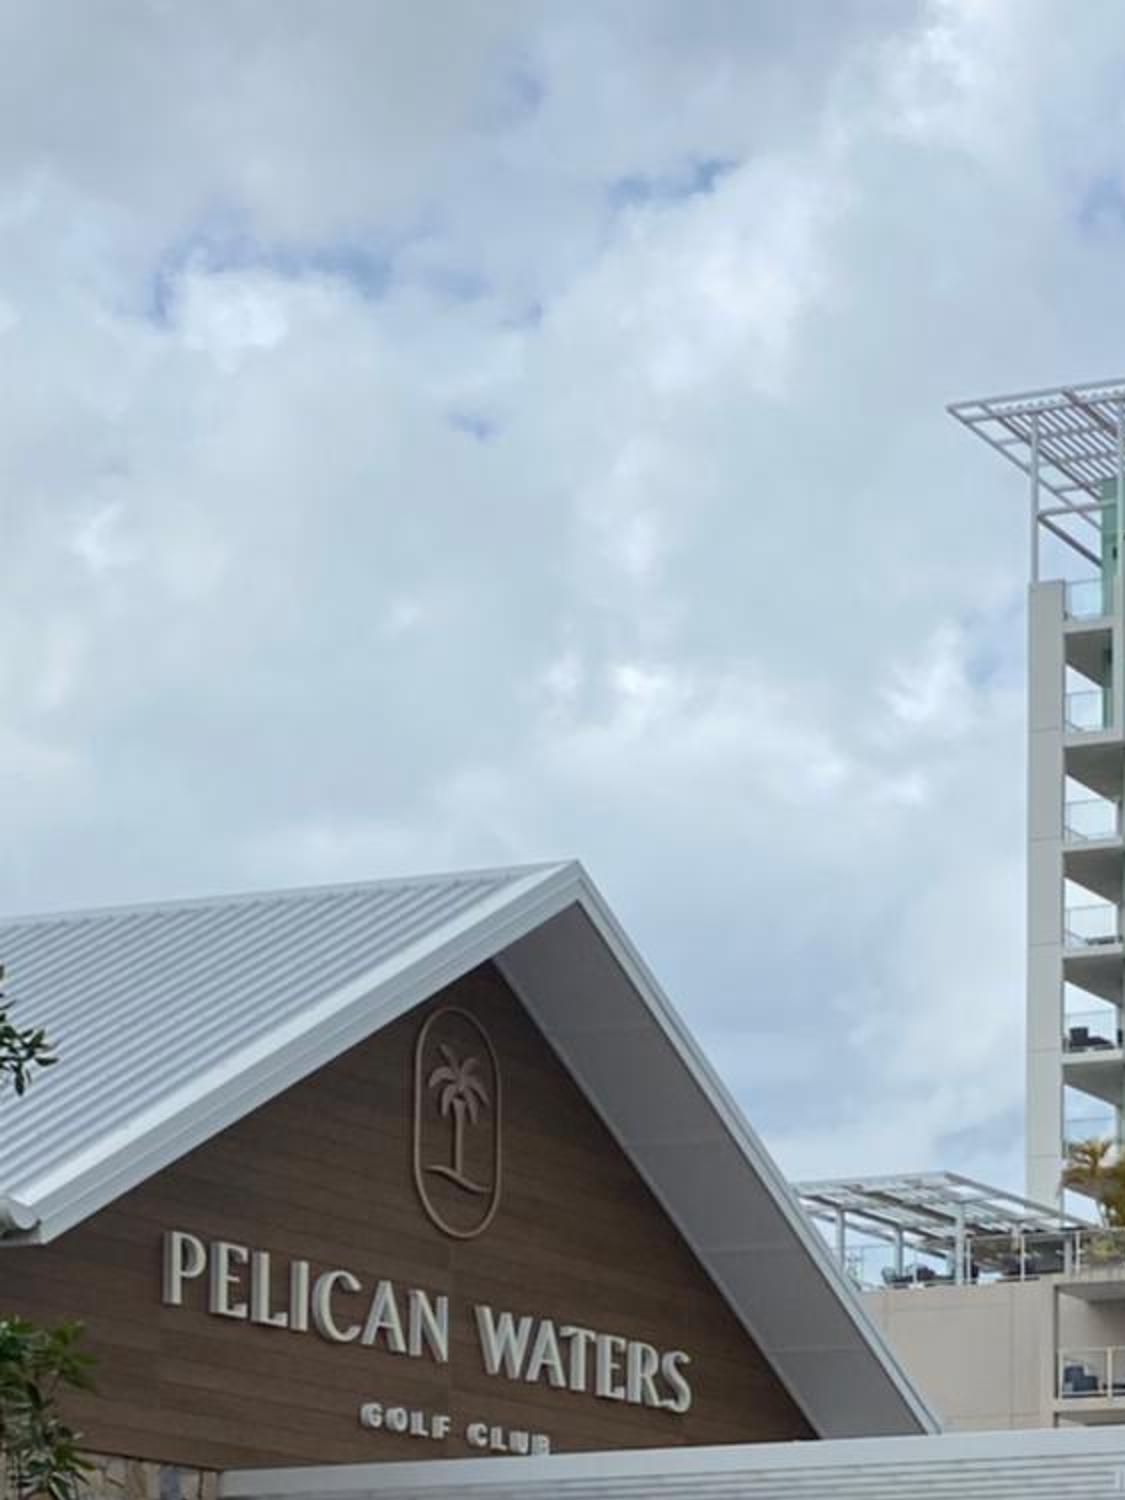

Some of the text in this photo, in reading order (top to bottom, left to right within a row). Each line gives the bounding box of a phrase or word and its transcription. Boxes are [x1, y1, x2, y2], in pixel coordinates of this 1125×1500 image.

[163, 1230, 693, 1415] PELICAN WATERS
[360, 1402, 550, 1456] GOLF CLUB
